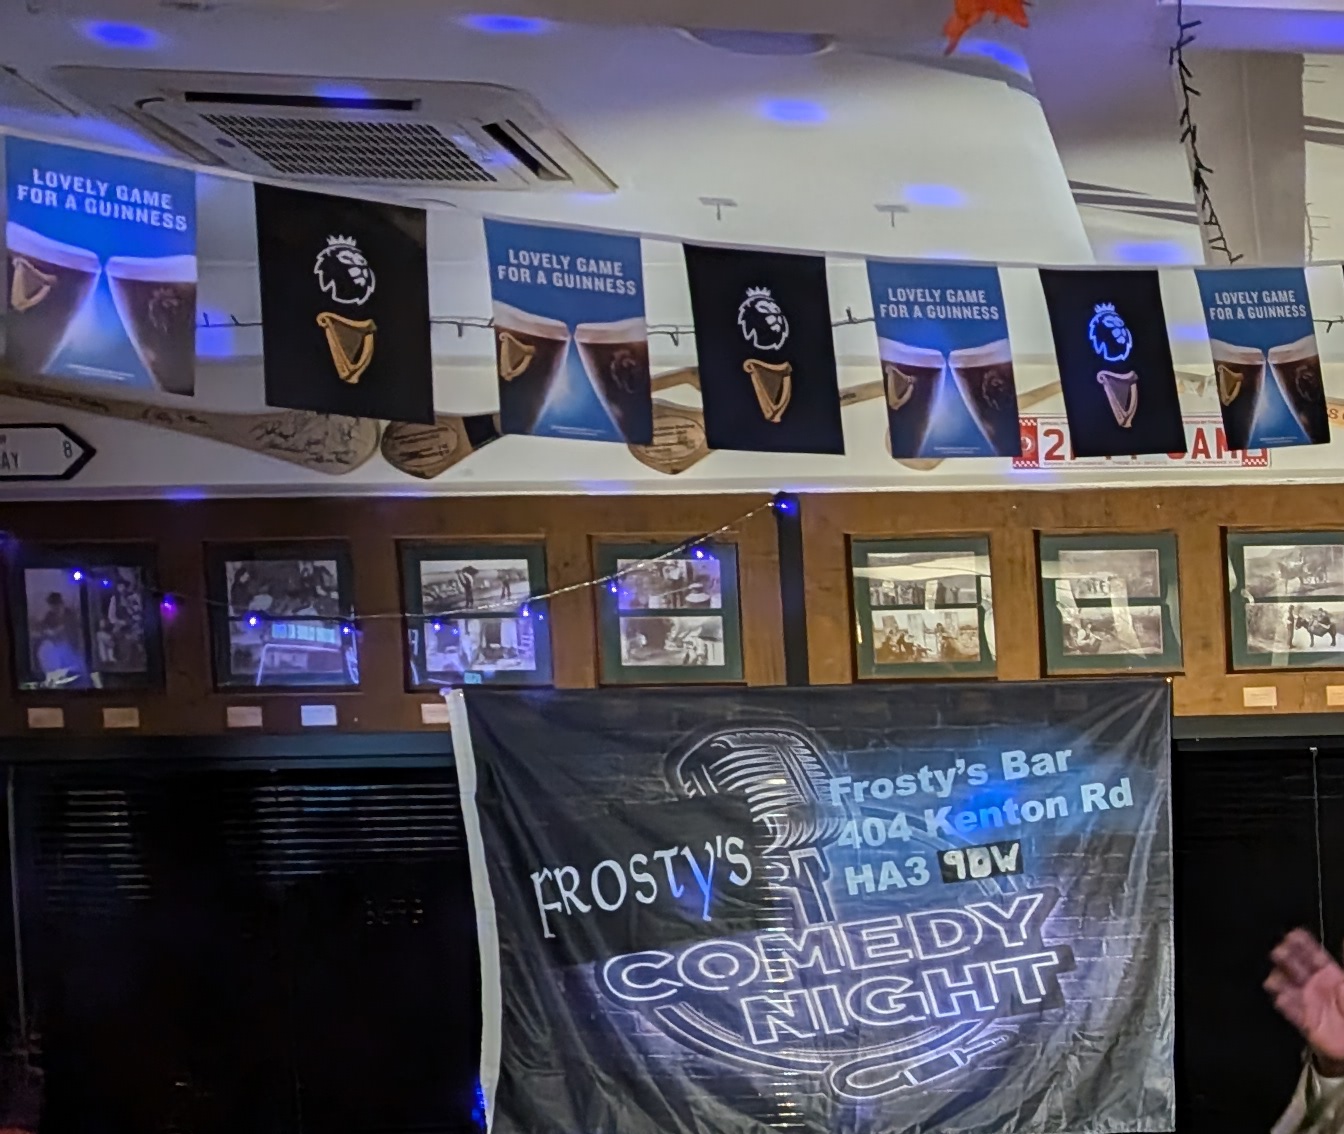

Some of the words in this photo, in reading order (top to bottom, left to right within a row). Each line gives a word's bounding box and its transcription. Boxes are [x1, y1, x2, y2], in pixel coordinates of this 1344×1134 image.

[18, 185, 58, 208] FOR
[64, 192, 76, 211] A
[83, 194, 187, 231] GUINNESS
[32, 168, 108, 198] LOVELY
[116, 183, 171, 210] GAME
[498, 265, 531, 283] FOR
[537, 268, 547, 286] A
[551, 269, 636, 295] GUINNESS
[508, 249, 569, 274] LOVELY
[576, 256, 623, 277] GAME
[879, 304, 907, 318] FOR
[911, 304, 921, 319] A
[925, 305, 999, 321] GUINNESS
[888, 288, 941, 304] LOVELY
[947, 289, 986, 304] GAME
[1209, 306, 1232, 320] FOR
[1237, 306, 1246, 319] A
[1248, 303, 1306, 319] GUINNESS
[1214, 292, 1258, 306] LOVELY
[1262, 291, 1296, 304] GAME
[62, 440, 73, 458] 8
[830, 759, 988, 806] Frosty's
[1001, 748, 1073, 782] Bar
[837, 815, 911, 850] 404
[923, 792, 1069, 837] Kenton
[1081, 778, 1133, 812] Rd
[531, 836, 752, 938] FROSTY'S
[844, 857, 931, 895] HA3
[603, 892, 1044, 1002] COMEDY
[742, 950, 1059, 1045] NIGHT
